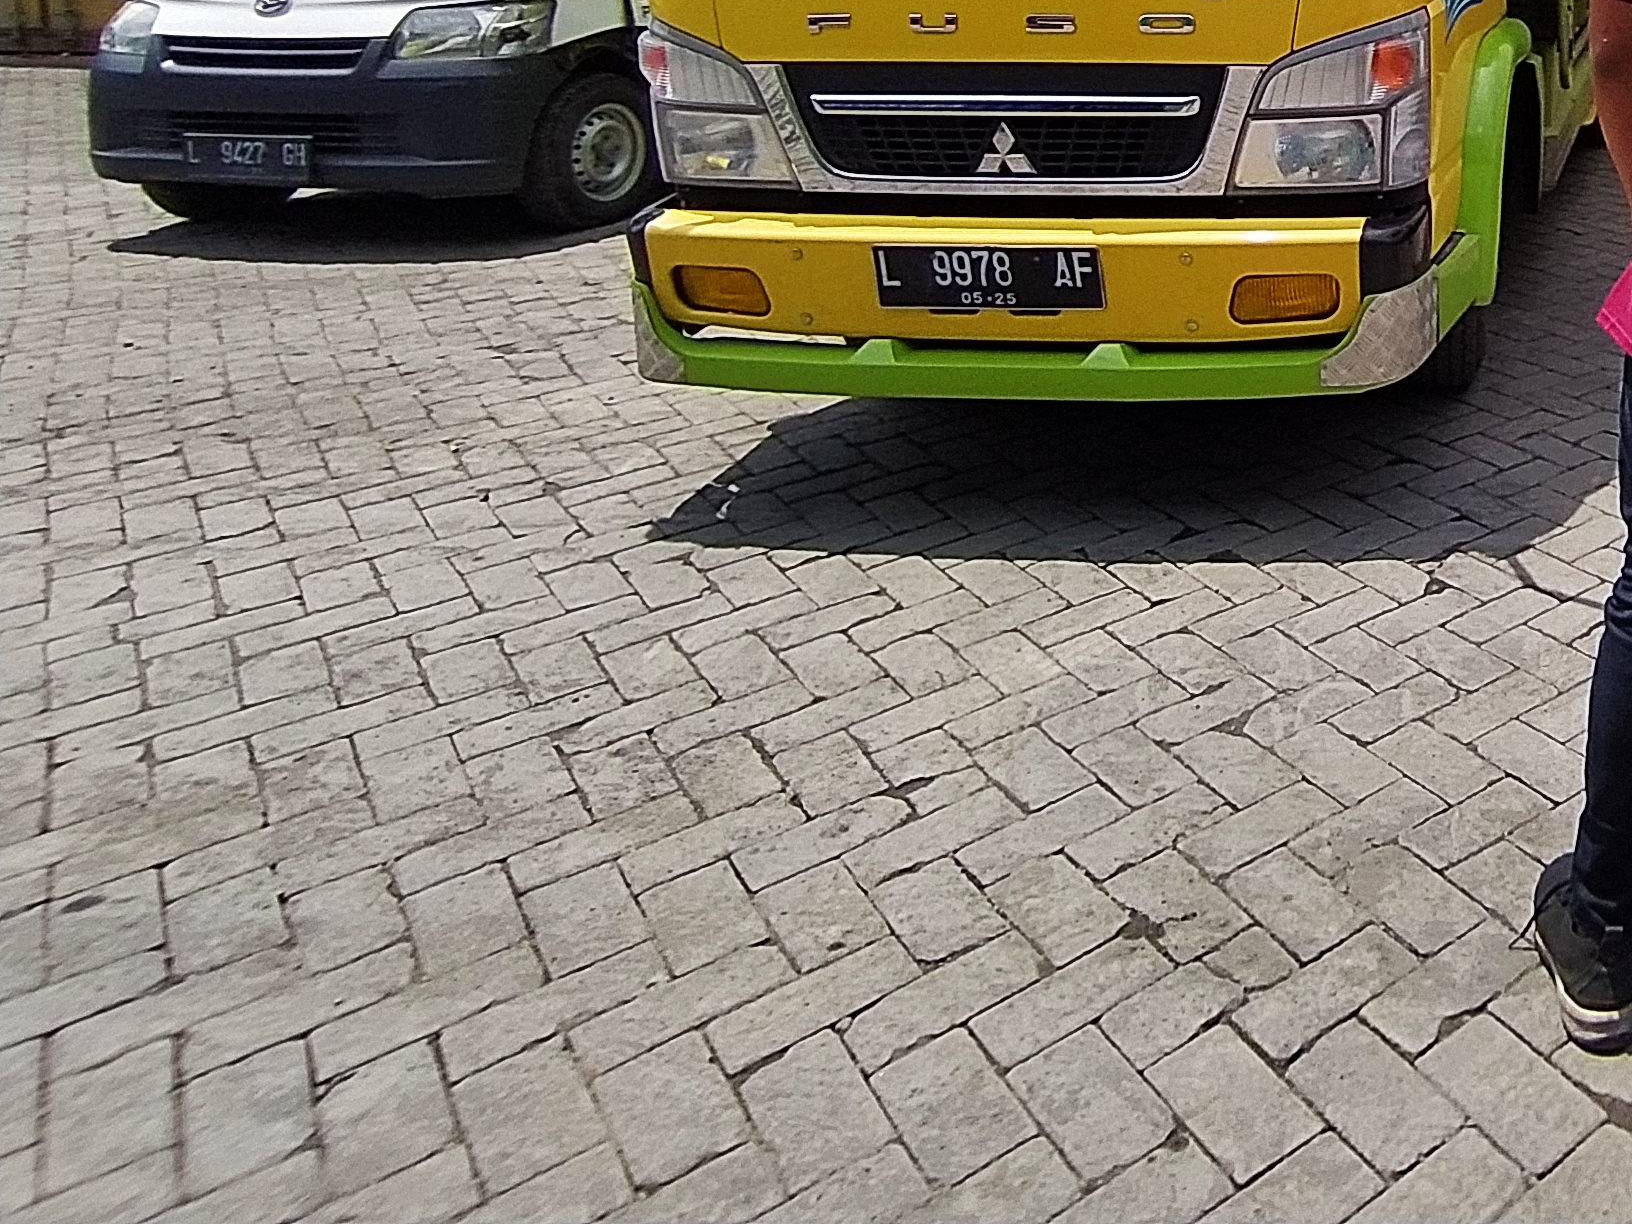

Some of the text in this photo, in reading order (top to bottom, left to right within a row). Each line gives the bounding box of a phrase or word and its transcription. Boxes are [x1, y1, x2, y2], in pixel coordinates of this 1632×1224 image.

[807, 13, 1196, 34] FUSO
[187, 140, 306, 167] L 9427 GH
[878, 250, 1093, 288] L 9978 AF
